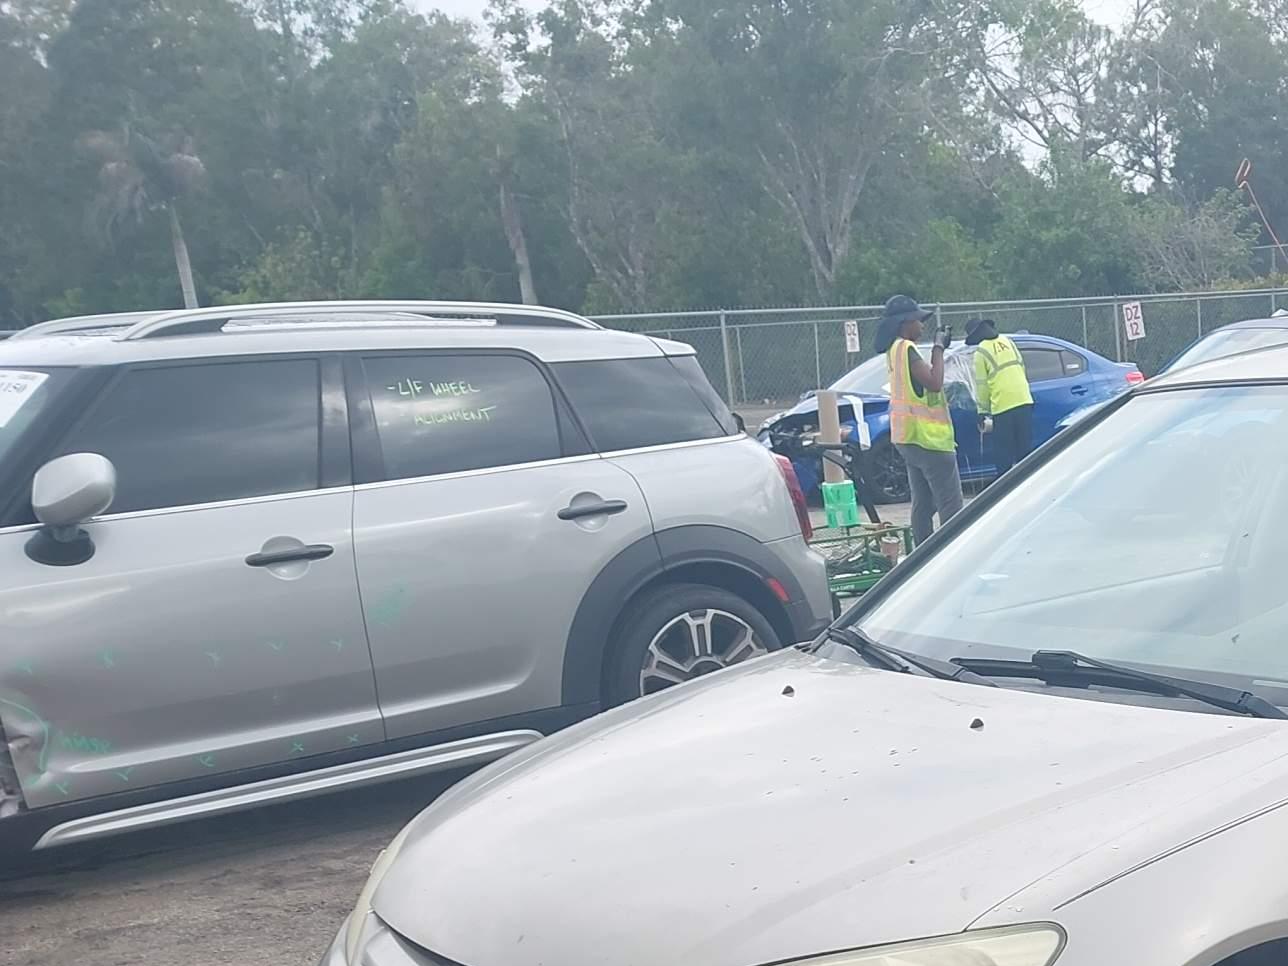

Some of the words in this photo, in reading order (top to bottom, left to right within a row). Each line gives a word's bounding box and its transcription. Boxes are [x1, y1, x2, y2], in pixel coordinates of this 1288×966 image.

[1125, 305, 1141, 321] DZ
[1130, 322, 1141, 336] 12
[430, 381, 481, 396] WHEEL
[414, 405, 497, 425] ALIGNMENT
